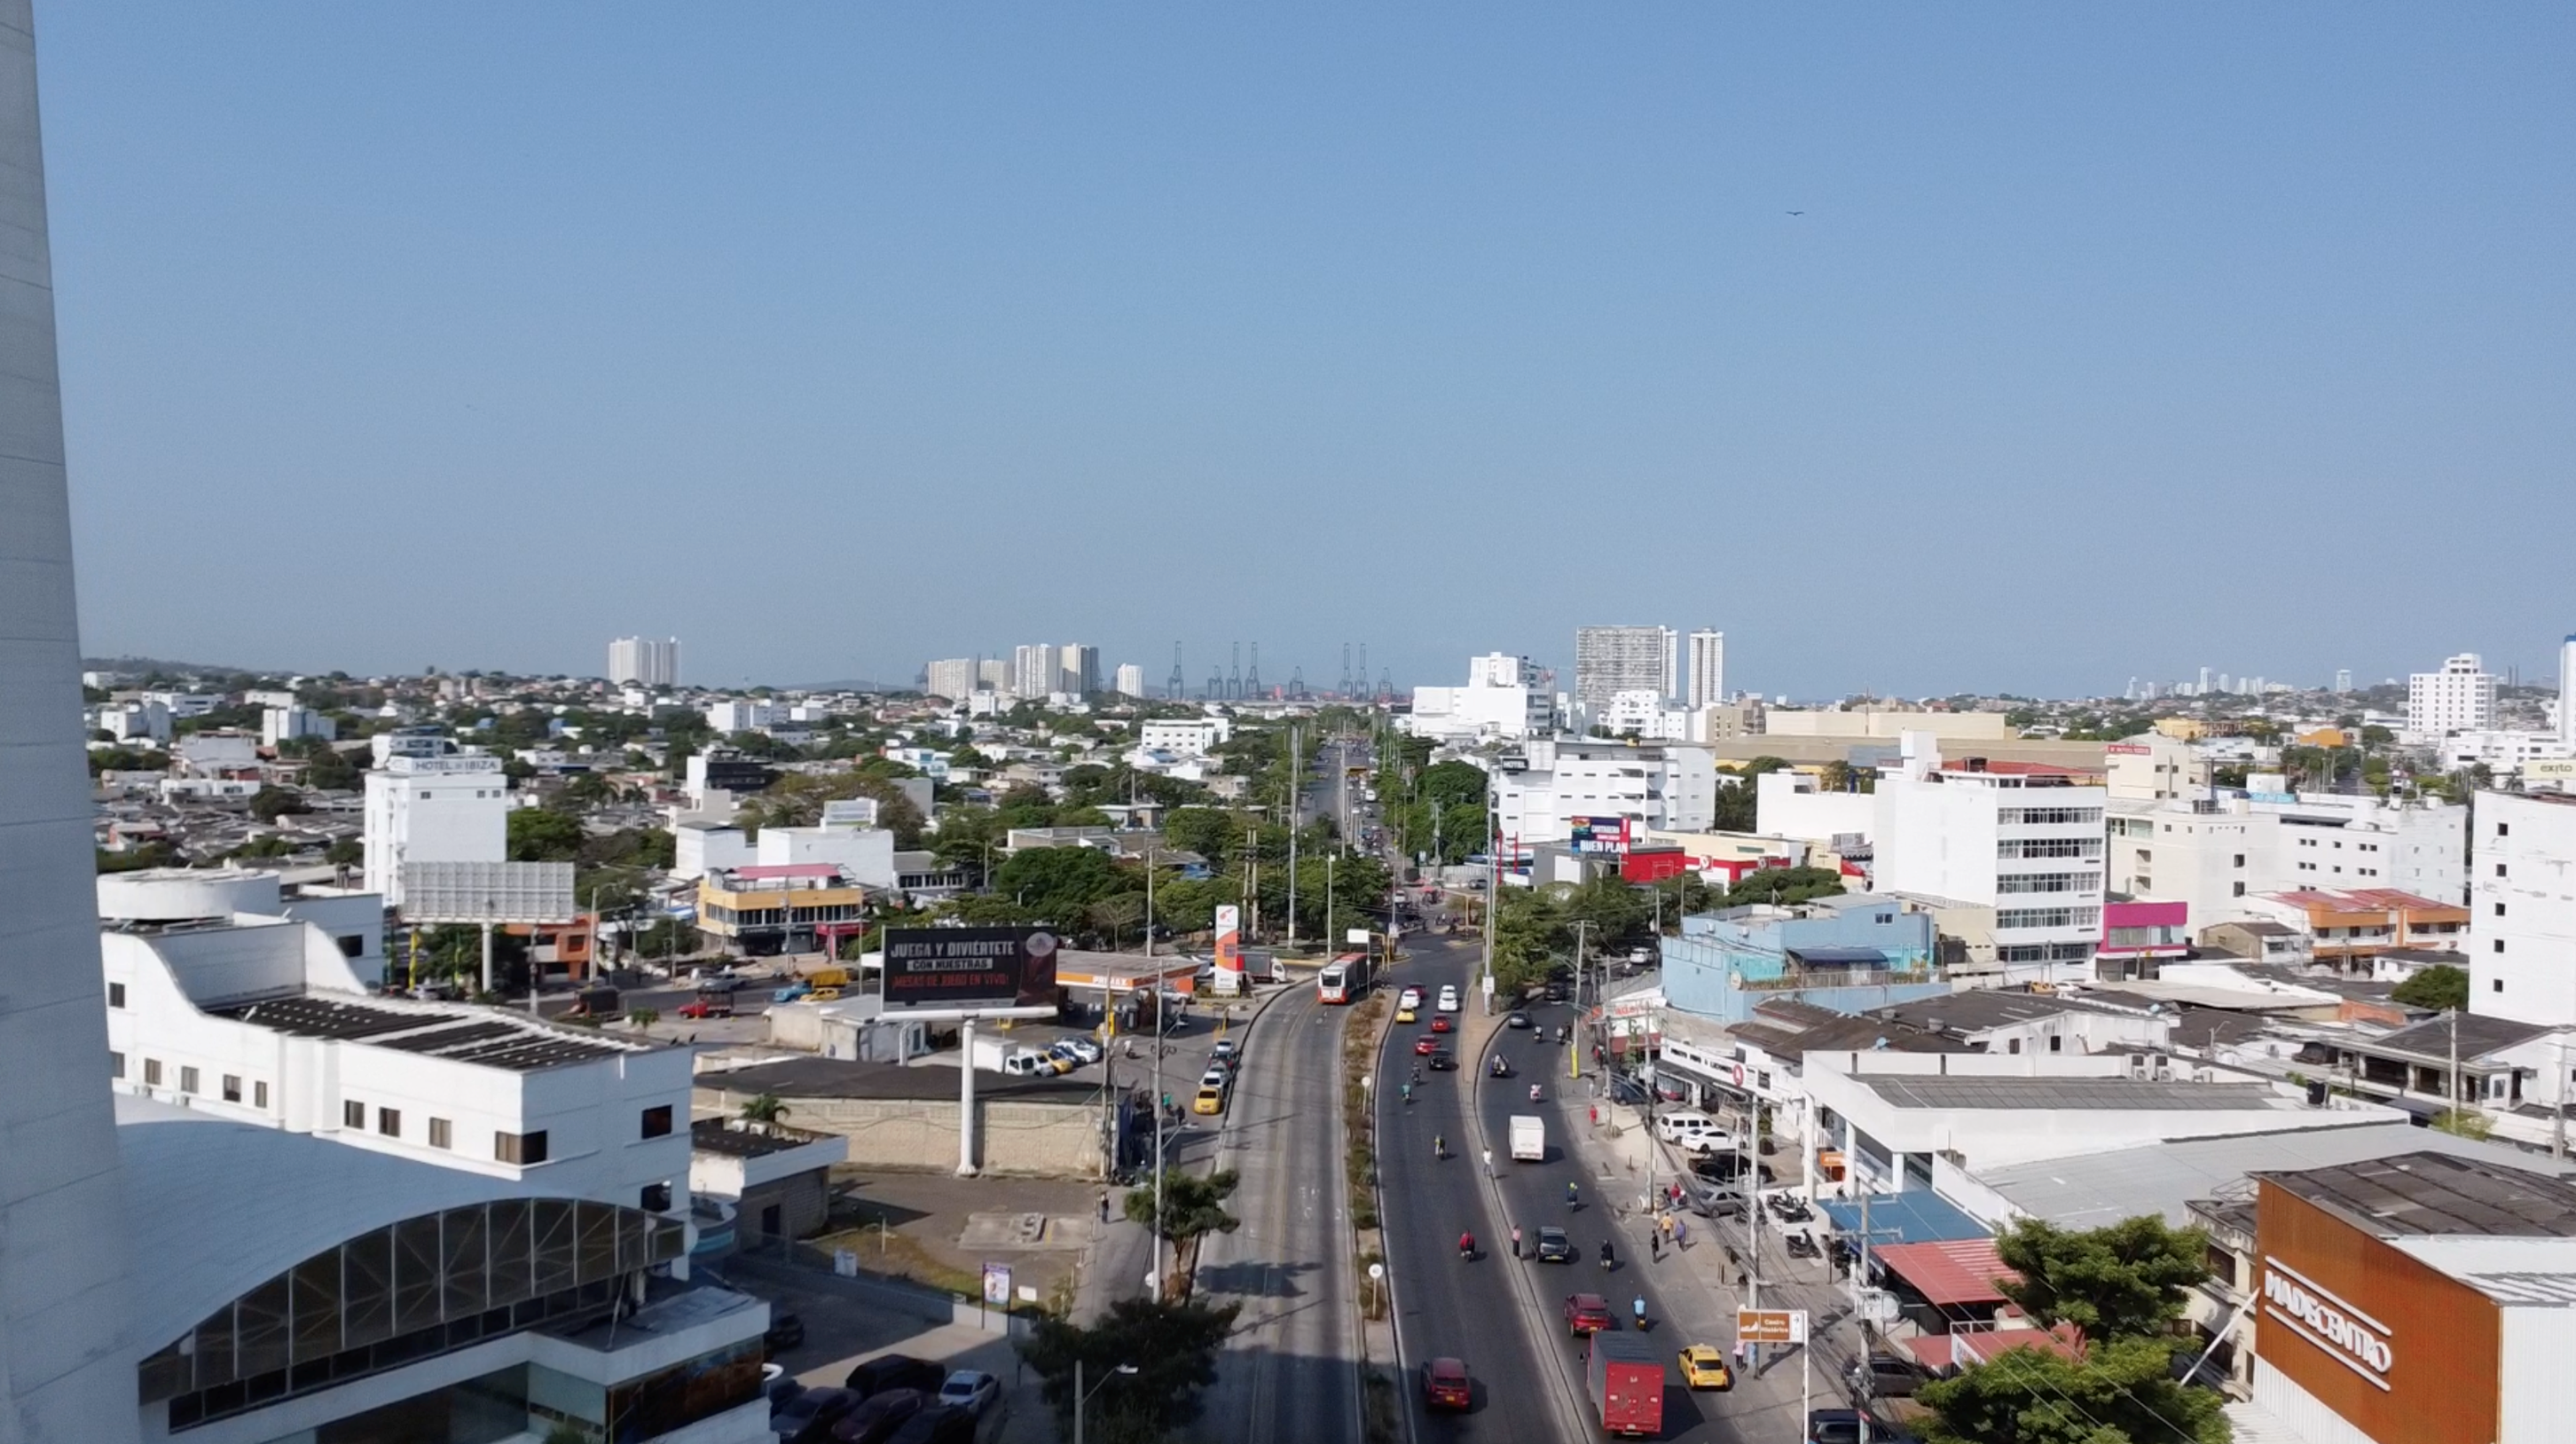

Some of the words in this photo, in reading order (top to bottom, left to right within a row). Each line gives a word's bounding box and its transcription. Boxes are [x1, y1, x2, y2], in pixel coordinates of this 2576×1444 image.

[415, 761, 452, 771] HOTEL
[465, 761, 497, 770] IBIZA
[1503, 760, 1527, 769] HOTEL
[1580, 839, 1603, 852] BUEN
[1605, 841, 1629, 854] PLAN
[891, 943, 931, 958] JUEGA
[936, 943, 944, 957] Y
[913, 959, 932, 970] CON
[935, 957, 988, 969] NUESTRAS
[927, 975, 938, 987] DE
[941, 974, 967, 987] JUEGO
[970, 973, 981, 986] EN
[1093, 976, 1128, 986] PRIMAX
[2265, 1269, 2392, 1373] MADECENTRO
